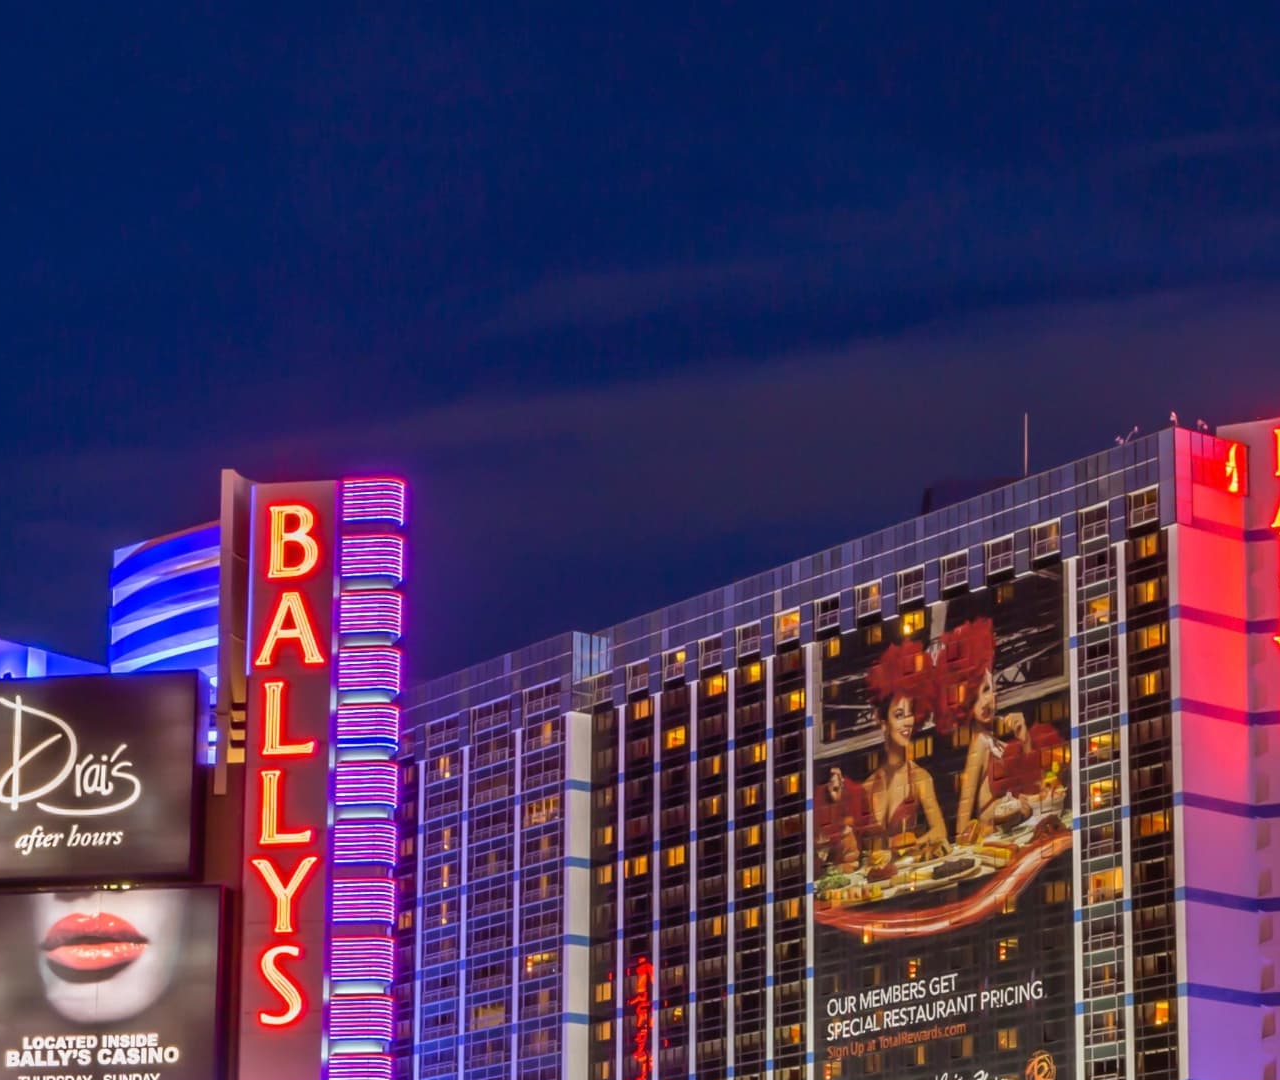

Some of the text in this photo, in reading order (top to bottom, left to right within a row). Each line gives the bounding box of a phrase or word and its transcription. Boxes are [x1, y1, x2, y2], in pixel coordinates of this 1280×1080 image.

[253, 505, 323, 1025] BALLYS
[15, 824, 123, 855] after hours
[826, 973, 958, 1017] OUR MEMBERS GET
[826, 1014, 881, 1042] SPECIAL
[883, 993, 977, 1029] RESTAURANT
[5, 1046, 179, 1067] BALLY'S CASINO
[23, 1033, 159, 1050] LOCATED INSIDE
[827, 1045, 849, 1059] Sign
[850, 1040, 865, 1057] Up
[878, 1023, 967, 1049] TotalRewards.com
